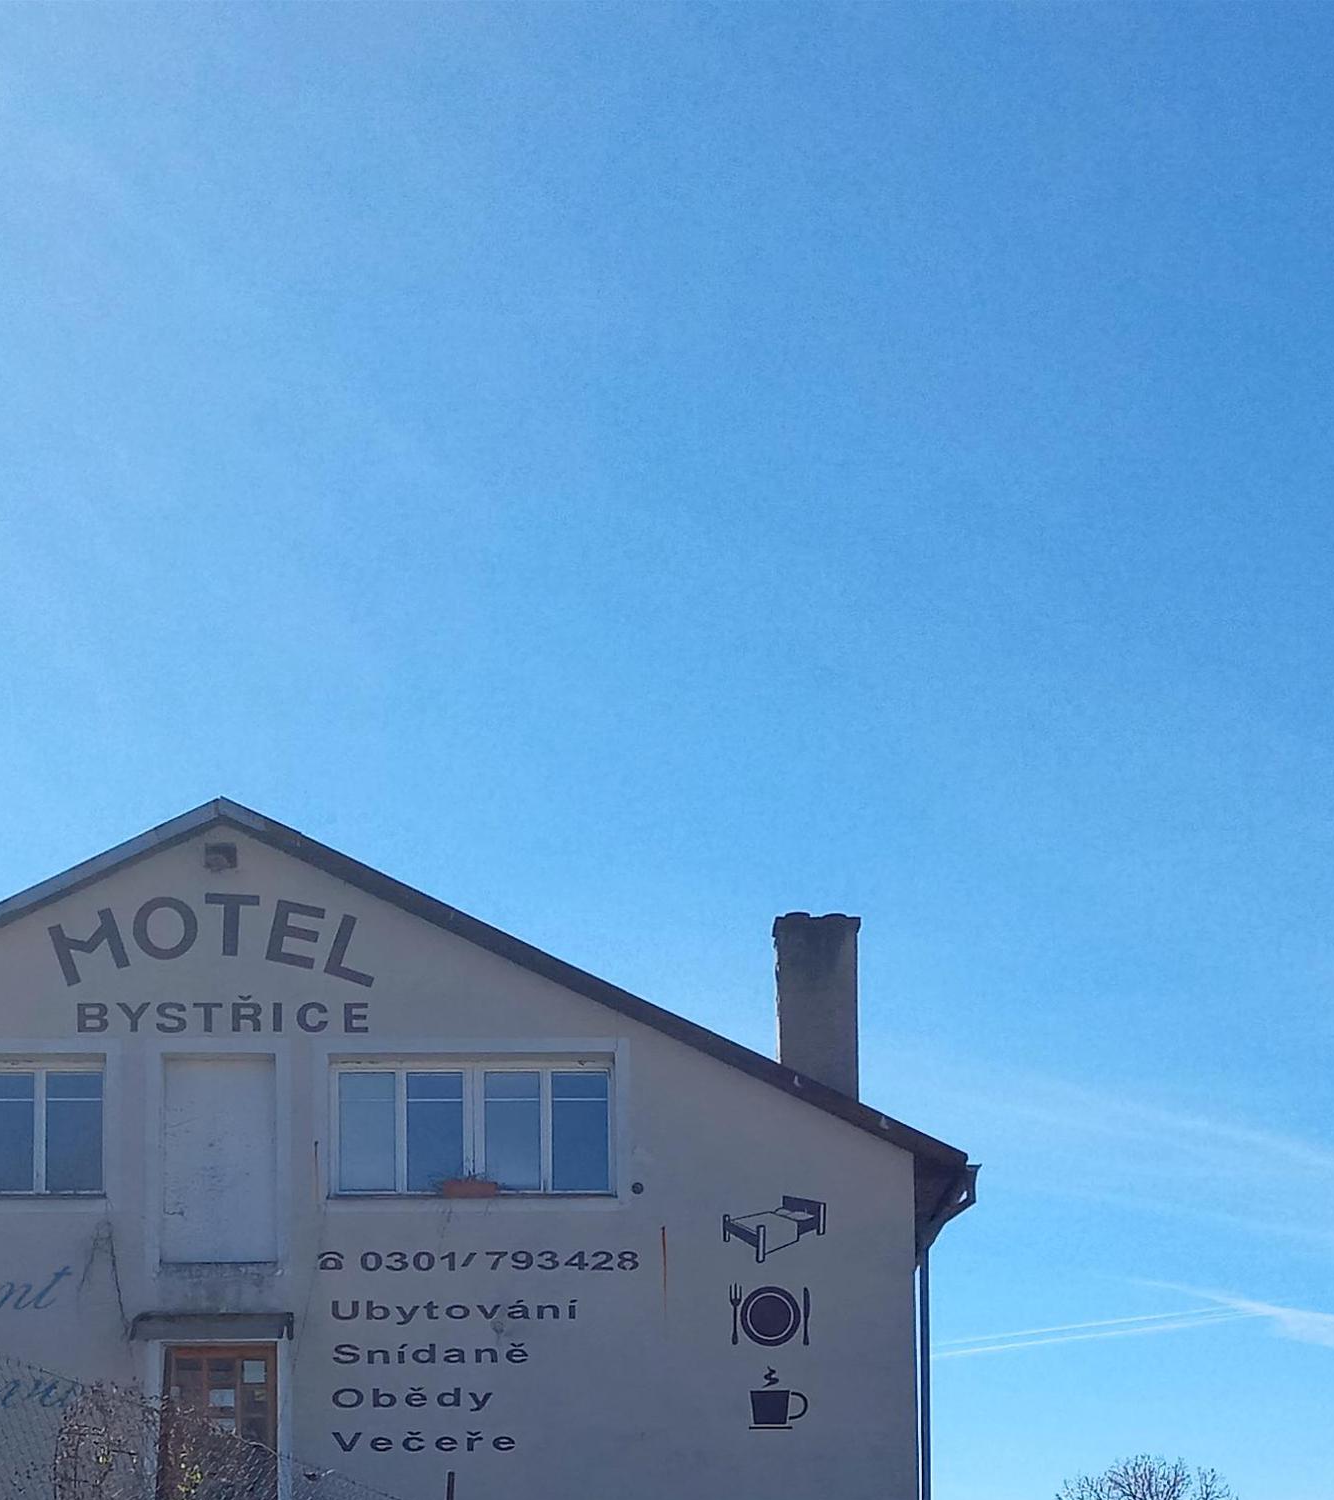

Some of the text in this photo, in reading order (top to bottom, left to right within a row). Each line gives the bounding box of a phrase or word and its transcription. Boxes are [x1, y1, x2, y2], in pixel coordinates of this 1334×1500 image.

[47, 893, 375, 987] MOTEL
[76, 995, 370, 1033] BYSTŘICE
[331, 1299, 578, 1324] Ubytování
[331, 1342, 531, 1365] Snídaně
[331, 1385, 494, 1411] Obědy
[331, 1431, 517, 1453] Večeře
